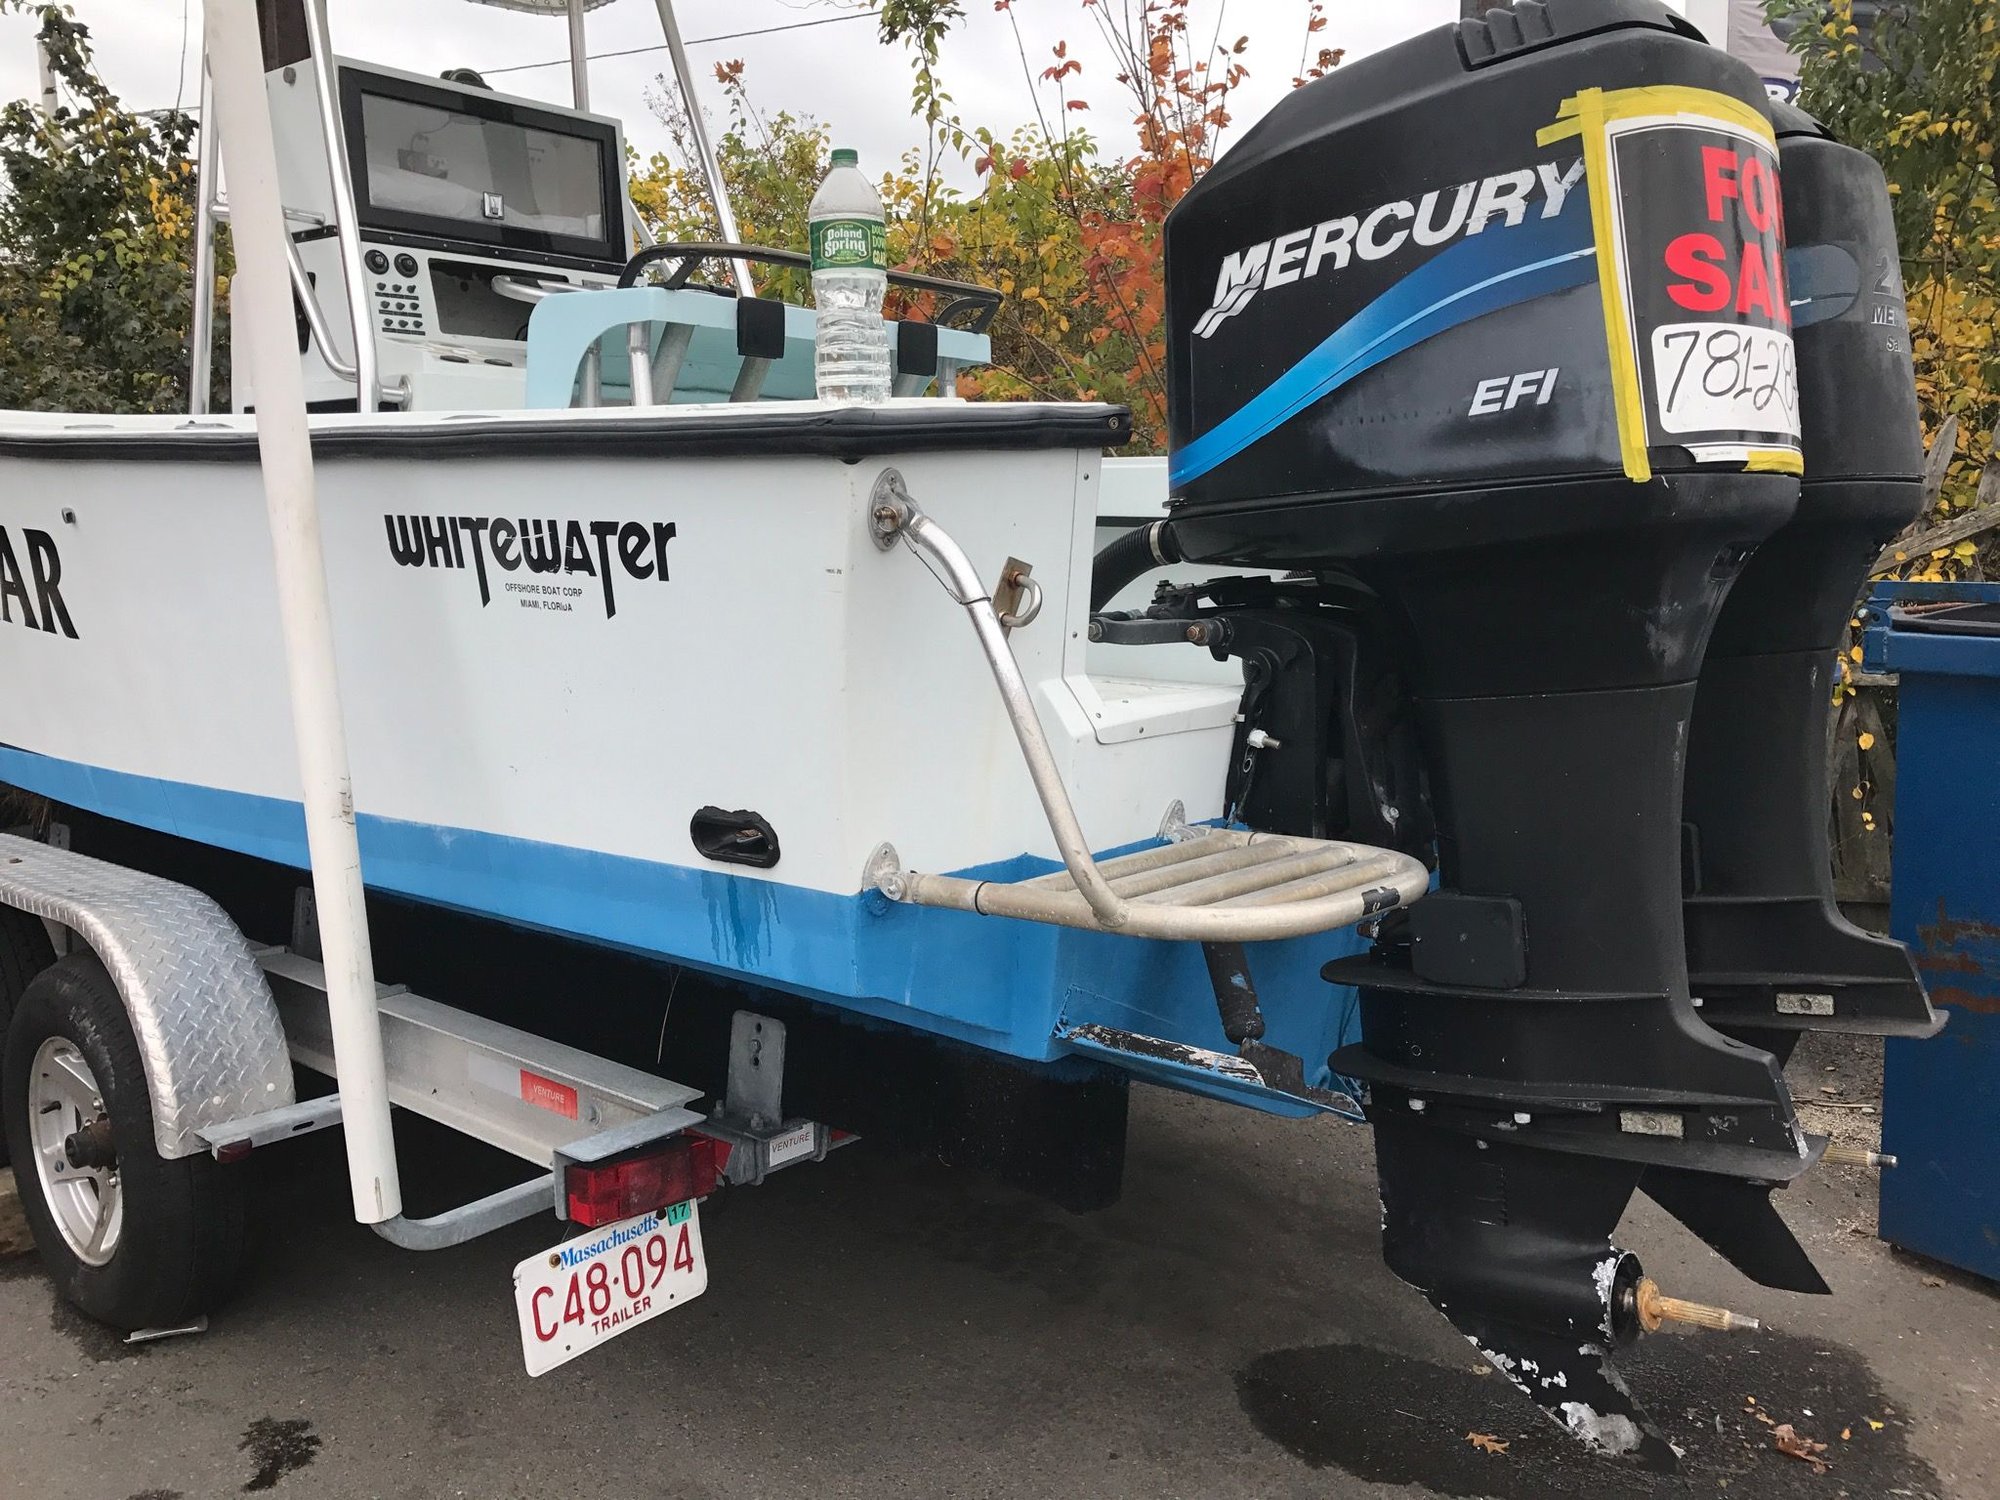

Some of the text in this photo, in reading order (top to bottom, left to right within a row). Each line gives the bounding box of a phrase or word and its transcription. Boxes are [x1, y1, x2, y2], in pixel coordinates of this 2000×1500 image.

[827, 228, 862, 240] Poland
[824, 238, 867, 257] Spring
[1193, 157, 1586, 339] MERCURY
[1468, 368, 1559, 416] EFI
[505, 582, 583, 597] OFFSHORE BOAT CORP
[520, 599, 542, 610] MIAMI,
[533, 1084, 565, 1104] VENTURE
[771, 1132, 811, 1153] VENTURE
[671, 1203, 687, 1220] 17
[560, 1214, 660, 1271] Massachusetts
[591, 1296, 652, 1336] TRAILER
